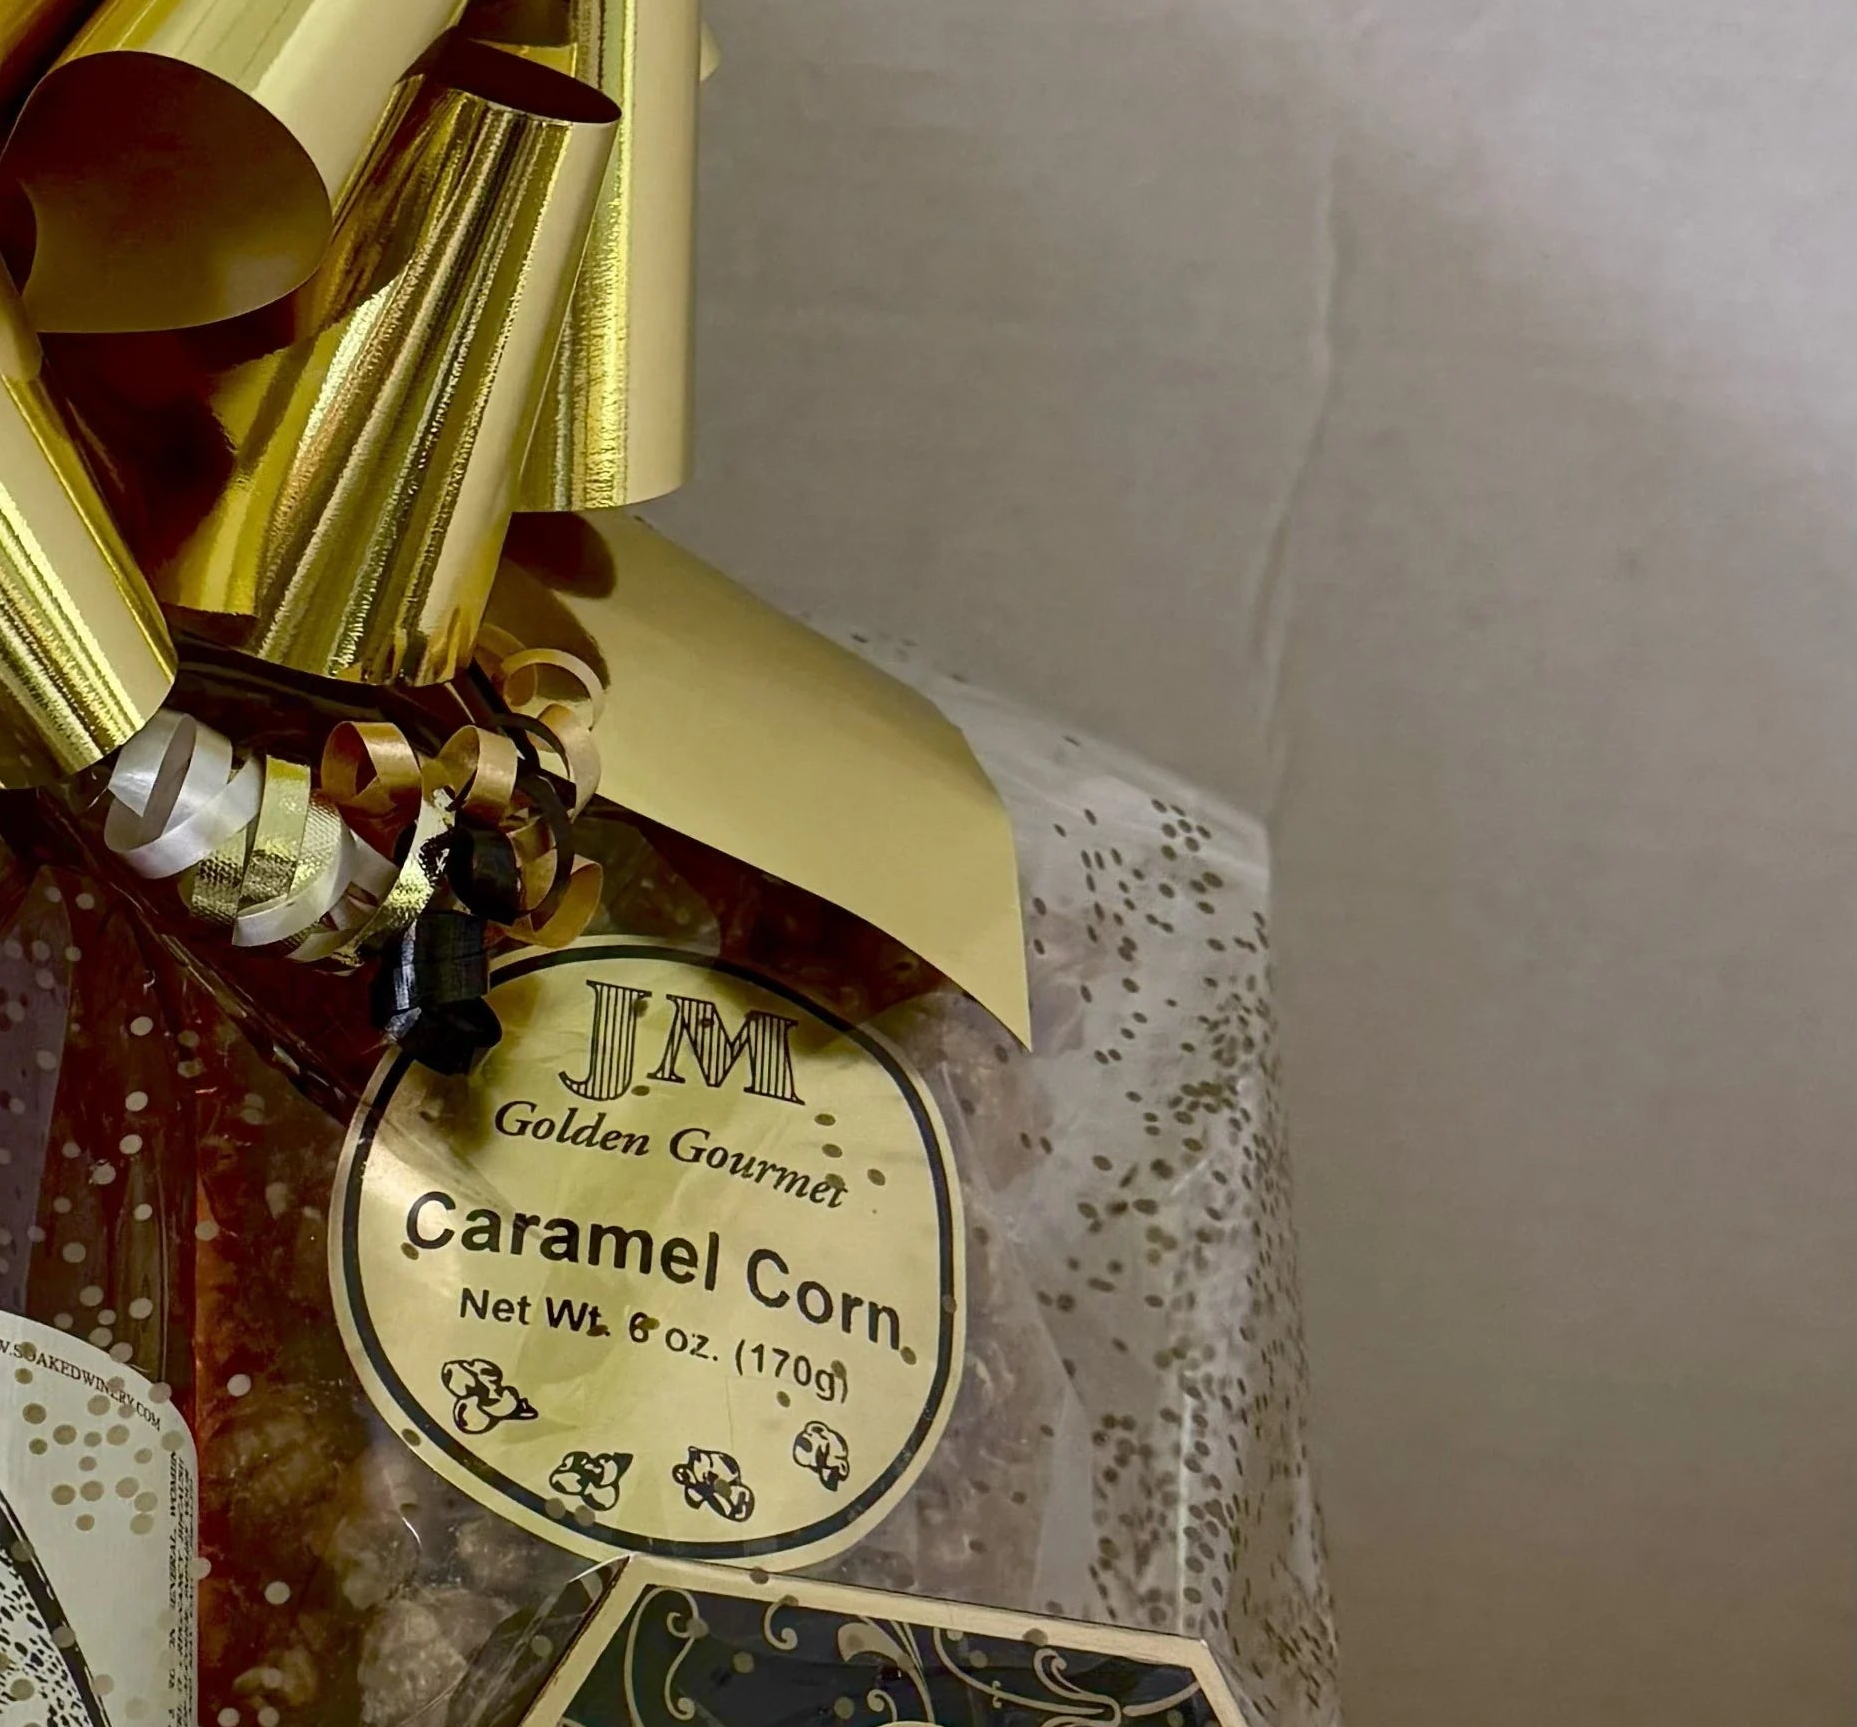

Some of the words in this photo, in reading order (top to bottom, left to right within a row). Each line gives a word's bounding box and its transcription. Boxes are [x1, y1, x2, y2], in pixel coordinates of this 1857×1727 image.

[557, 979, 805, 1105] JM
[493, 1099, 651, 1158] Golden
[668, 1126, 849, 1210] Gourmet
[405, 1190, 720, 1291] Caramel
[746, 1249, 903, 1351] Corn
[458, 1287, 532, 1328] Net
[543, 1297, 611, 1336] Wt.
[628, 1311, 651, 1343] 6
[664, 1328, 719, 1363] oz.
[733, 1338, 849, 1406] (170g)
